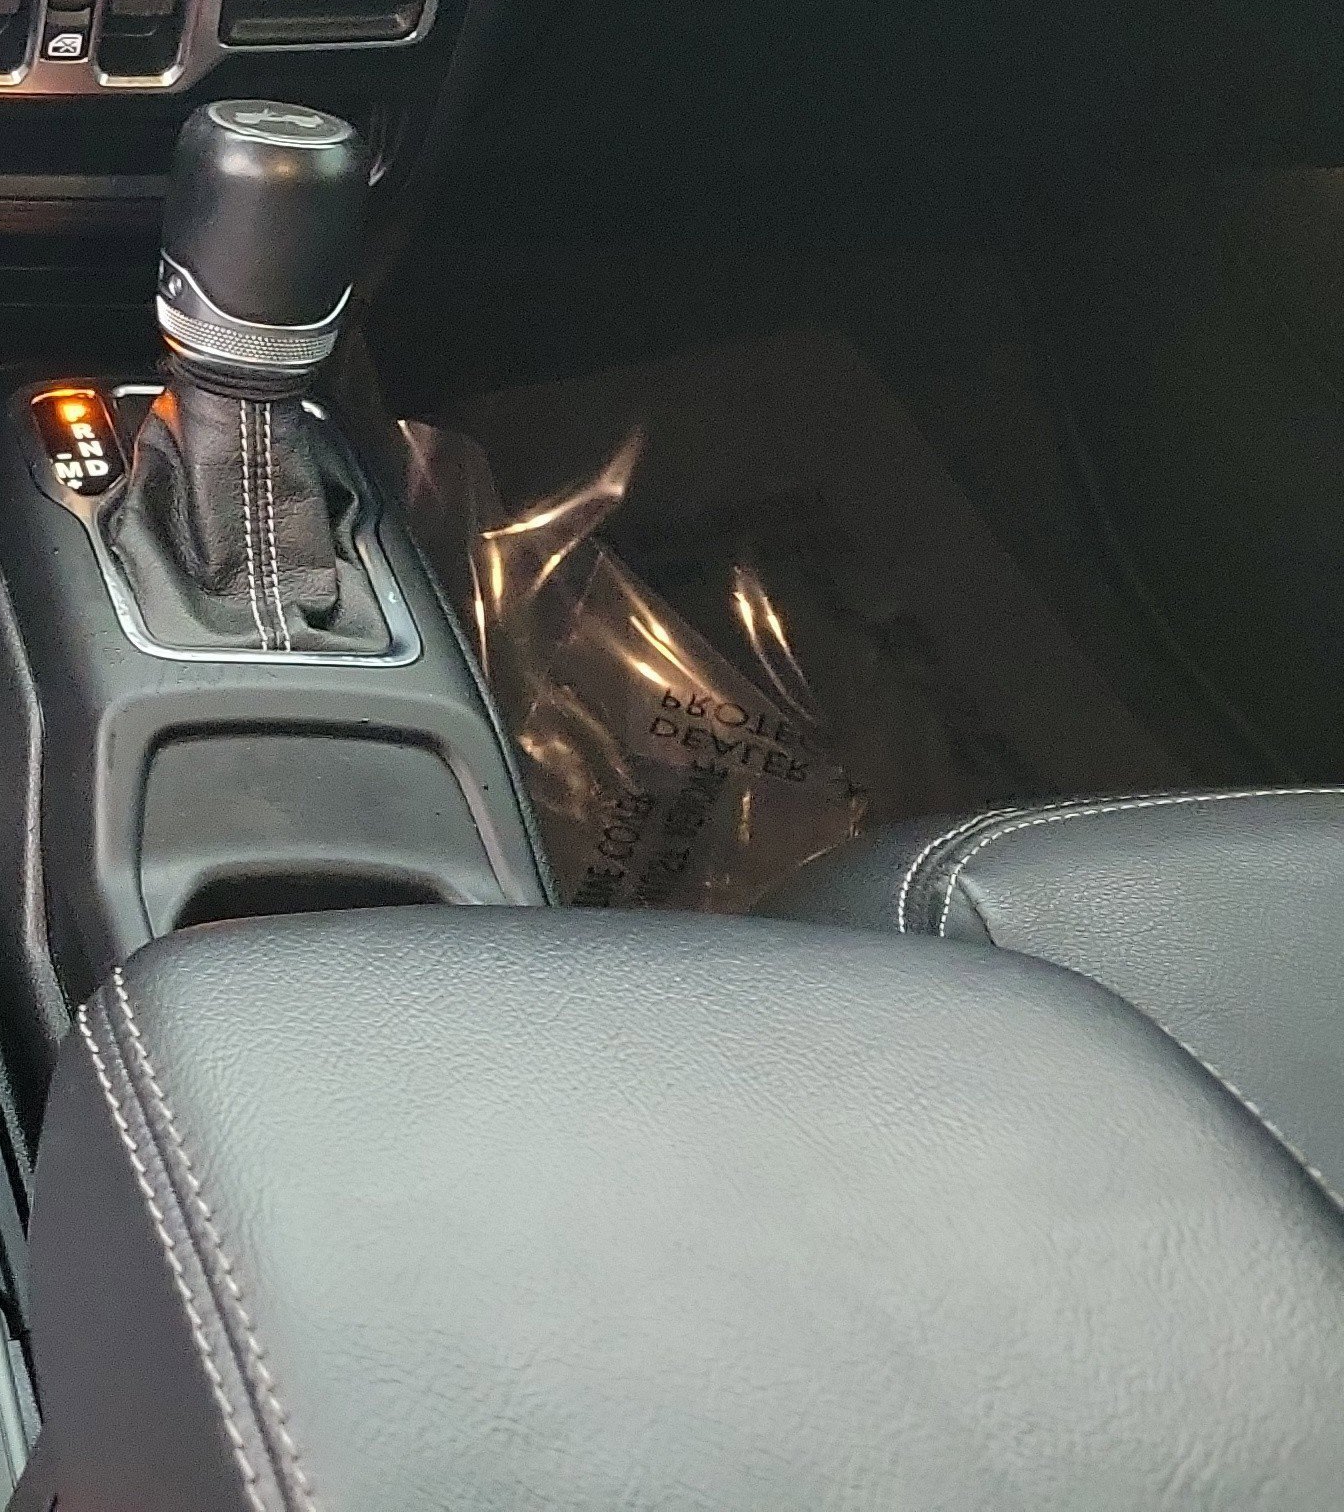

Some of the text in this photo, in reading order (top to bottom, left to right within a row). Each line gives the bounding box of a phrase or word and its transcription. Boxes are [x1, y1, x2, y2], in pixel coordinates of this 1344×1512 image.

[71, 423, 95, 439] R
[78, 441, 103, 457] N
[55, 462, 83, 478] M
[85, 460, 109, 476] D
